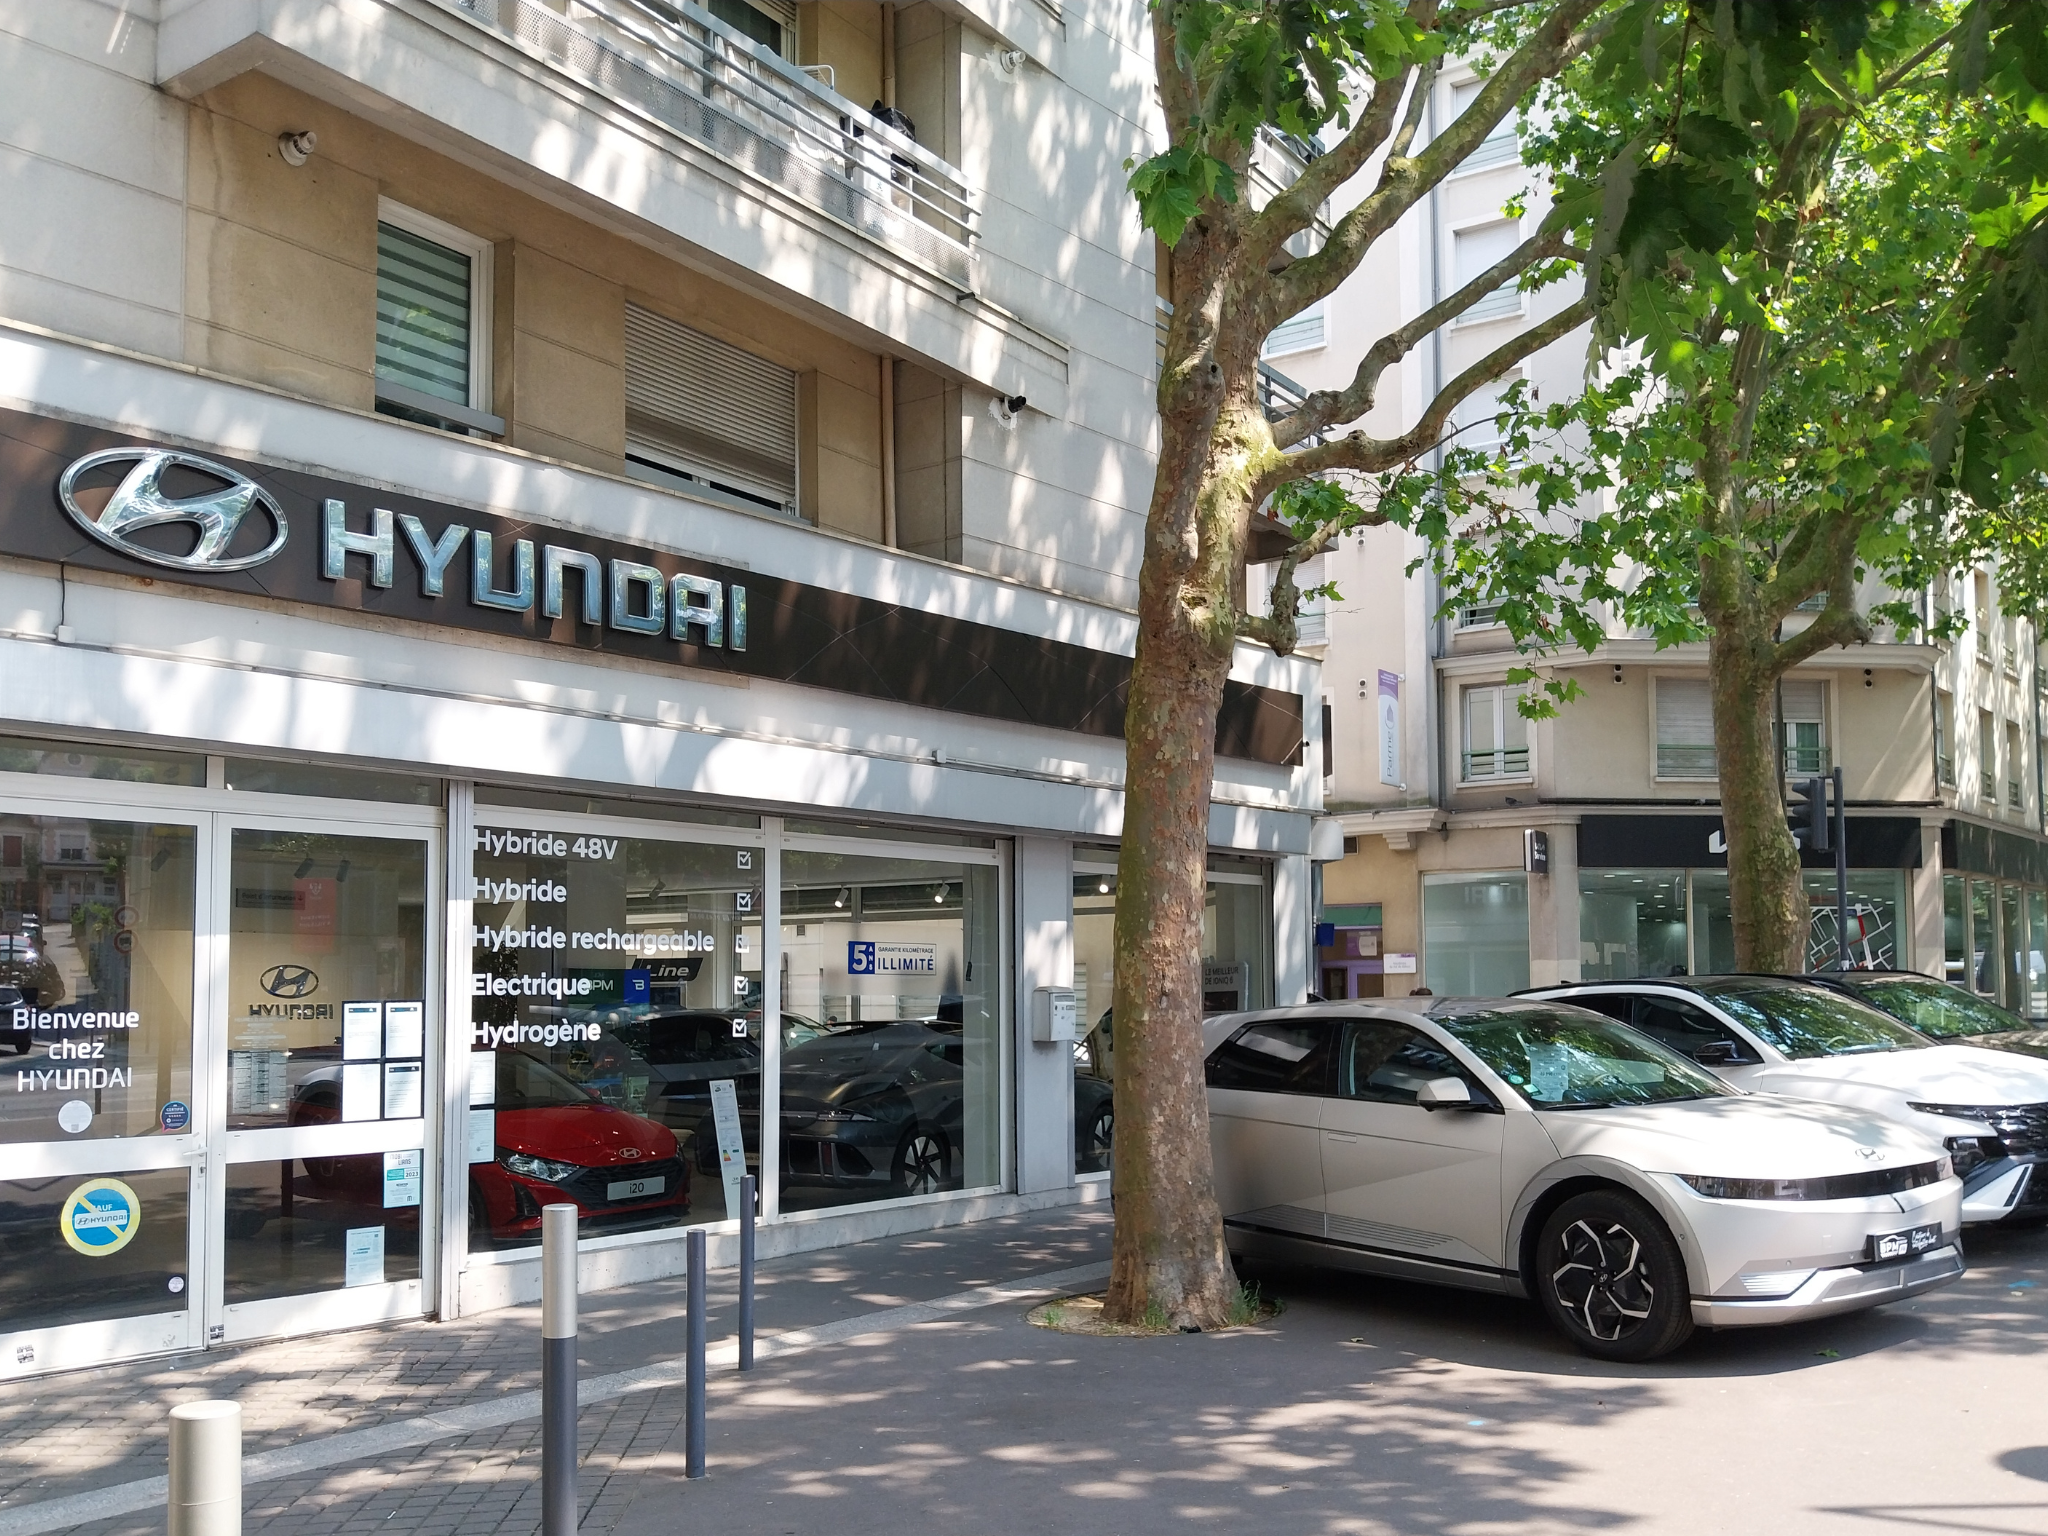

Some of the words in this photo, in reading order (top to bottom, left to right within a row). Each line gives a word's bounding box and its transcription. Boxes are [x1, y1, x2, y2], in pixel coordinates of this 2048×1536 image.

[323, 498, 747, 652] HYUNDAI
[473, 828, 567, 857] Hybride
[572, 837, 619, 860] 48V
[473, 877, 567, 904] Hybride
[472, 925, 566, 952] Hybride
[572, 928, 714, 955] rechargeable
[902, 946, 933, 954] KILOMÉTRAGE
[852, 944, 867, 971] 5
[877, 955, 934, 971] ILLIMITÉ
[646, 964, 689, 977] Line
[1205, 968, 1211, 976] LE
[1213, 966, 1239, 975] MEILLEUR
[1205, 977, 1211, 985] DE
[471, 972, 591, 1001] Electrique
[13, 1008, 140, 1030] Bienvenue
[249, 1004, 334, 1020] HYUNDAI
[471, 1019, 601, 1049] Hydrogène
[48, 1038, 105, 1060] chez
[17, 1067, 132, 1092] HYUNDAI
[629, 1182, 644, 1194] i20
[91, 1214, 127, 1223] HYUNDAI
[1880, 1241, 1899, 1253] BPM
